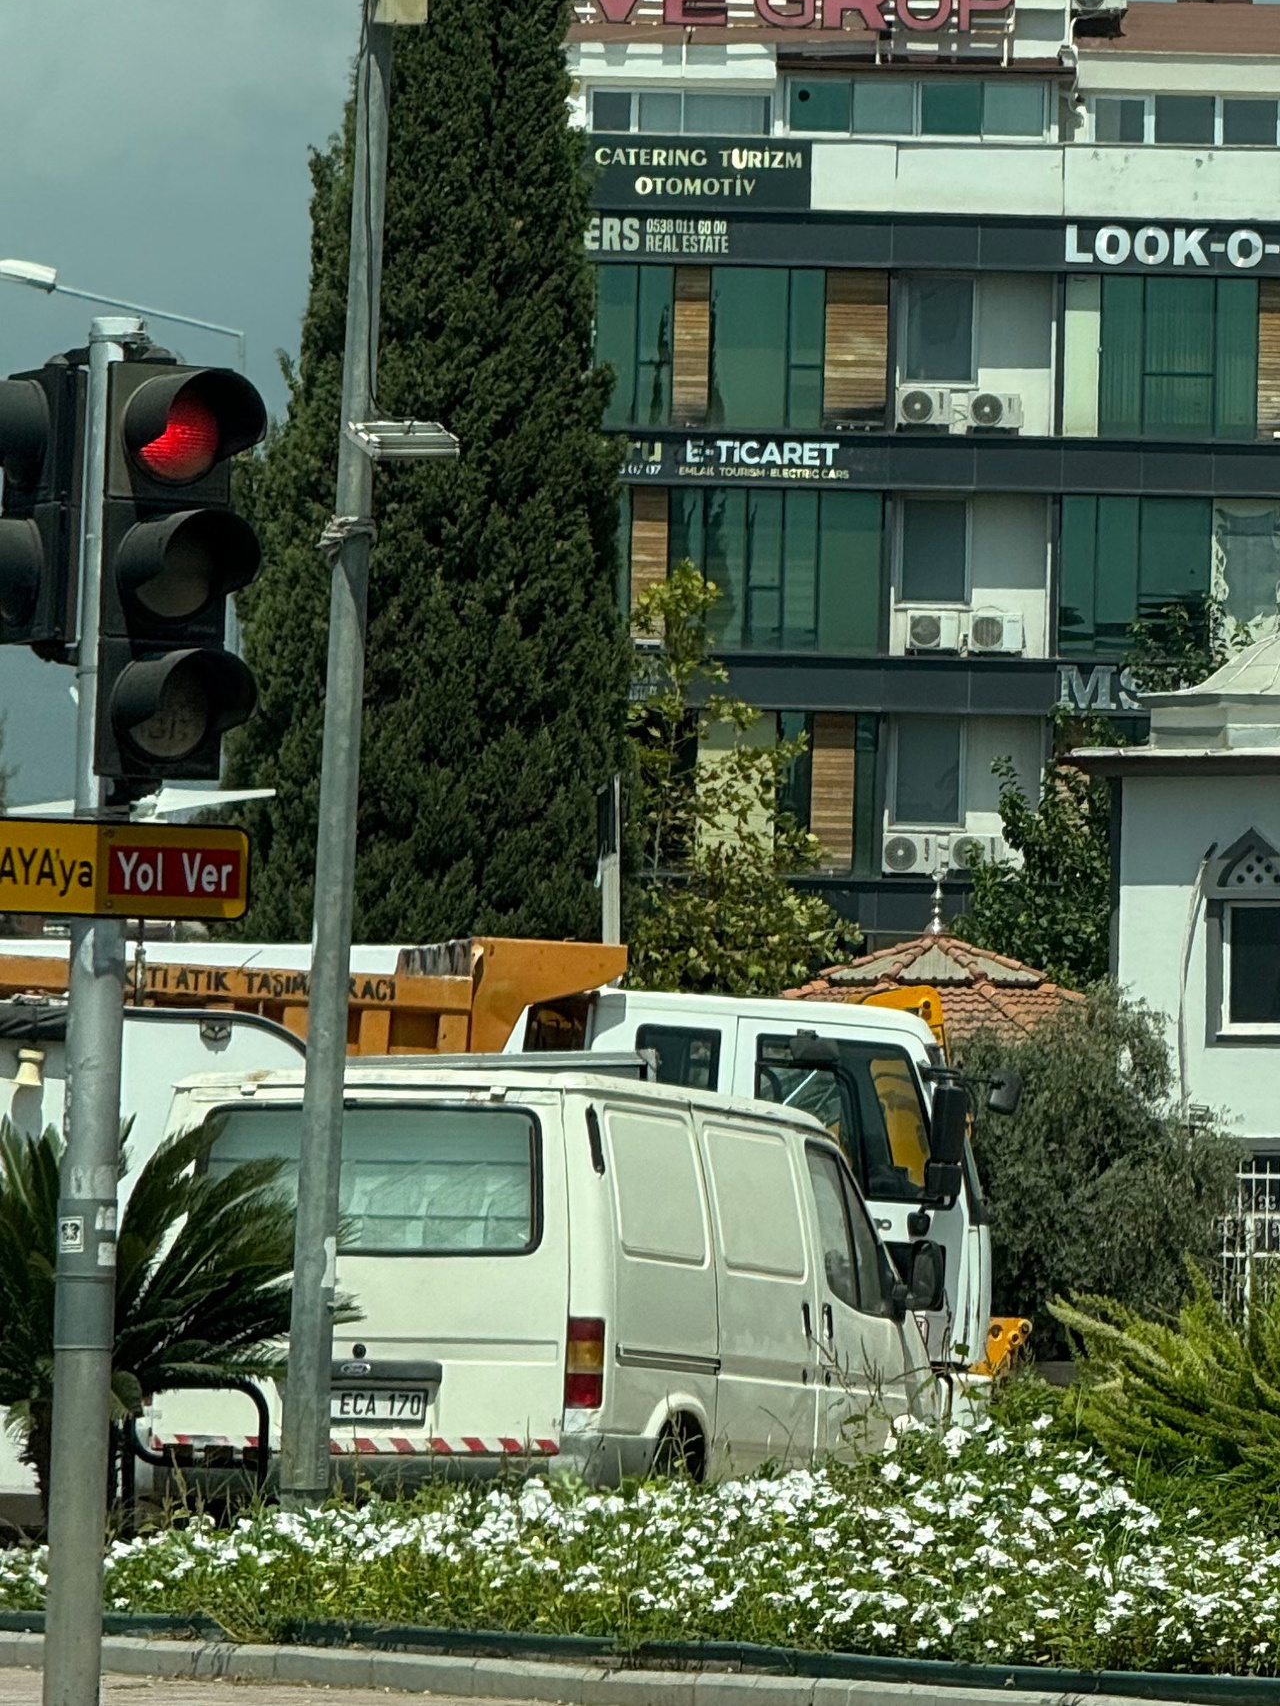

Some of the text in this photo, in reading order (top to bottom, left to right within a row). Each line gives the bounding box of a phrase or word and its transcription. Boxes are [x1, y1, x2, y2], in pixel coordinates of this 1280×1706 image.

[594, 146, 803, 169] CATERING TURİZM
[634, 174, 756, 196] OTOMOTİV
[646, 218, 674, 234] 0538
[675, 219, 696, 235] 011
[713, 221, 727, 235] 00
[645, 234, 729, 254] REAL ESTATE
[719, 466, 765, 478] TOURISM
[769, 467, 820, 480] ELECTRIC
[821, 468, 850, 480] CARS
[117, 851, 164, 893] Yol
[181, 852, 233, 893] Ver
[176, 967, 231, 992] ATIK
[243, 971, 312, 998] TAŞIM
[347, 978, 397, 1002] RACI
[339, 1393, 422, 1417] ECA 170
